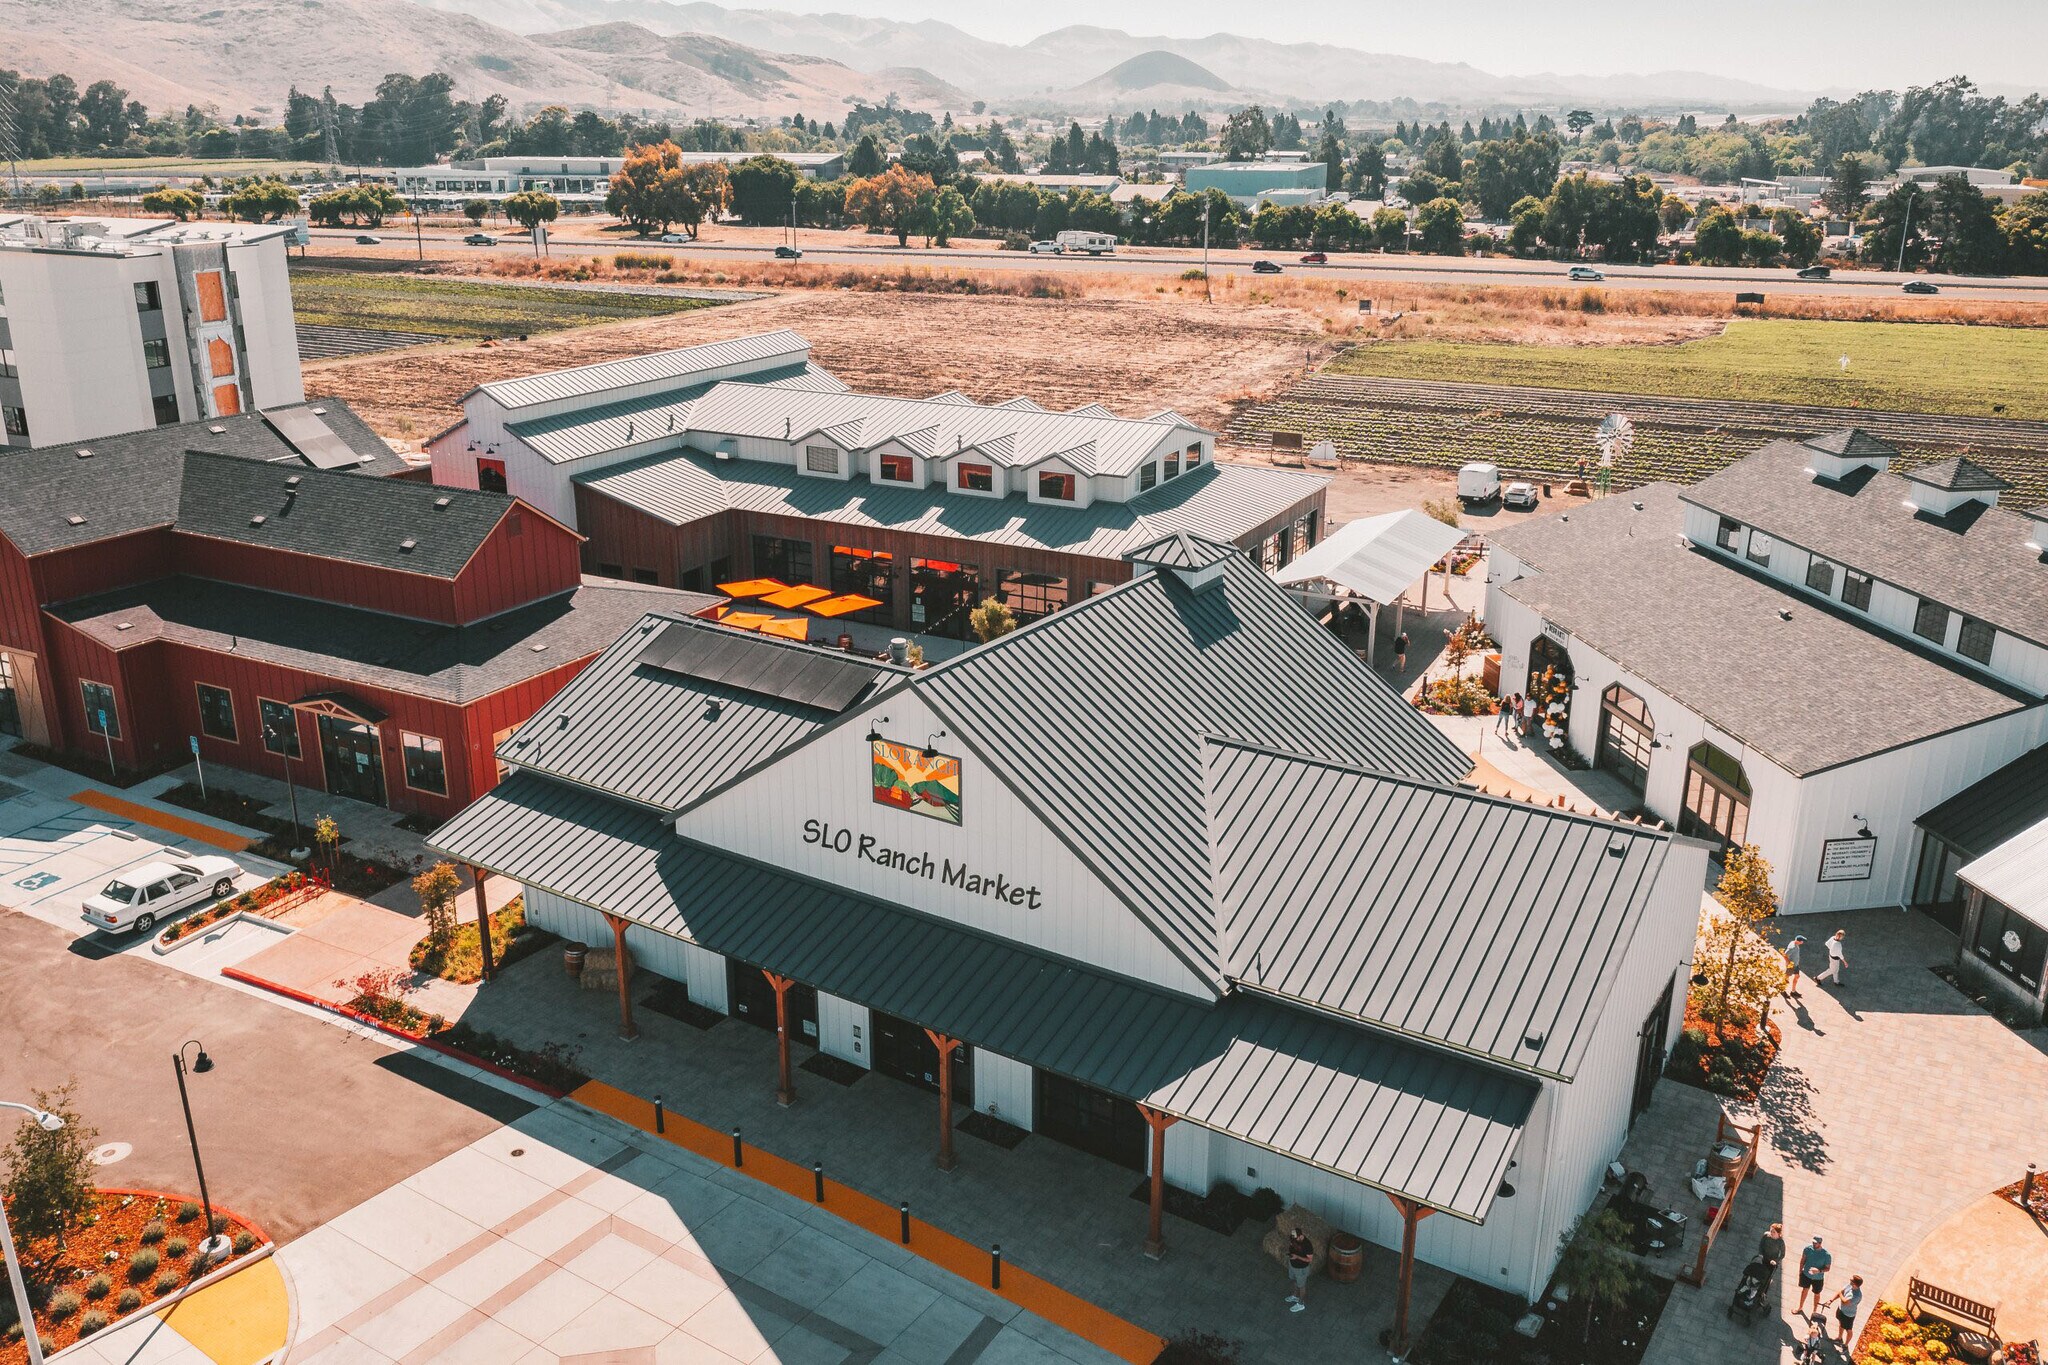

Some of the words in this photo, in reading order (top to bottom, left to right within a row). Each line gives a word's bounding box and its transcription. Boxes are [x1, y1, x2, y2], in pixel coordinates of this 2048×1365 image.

[874, 742, 900, 761] SLO
[903, 749, 957, 776] RANCH
[802, 819, 851, 853] SLO
[857, 833, 935, 880] Ranch
[941, 858, 1042, 910] Market
